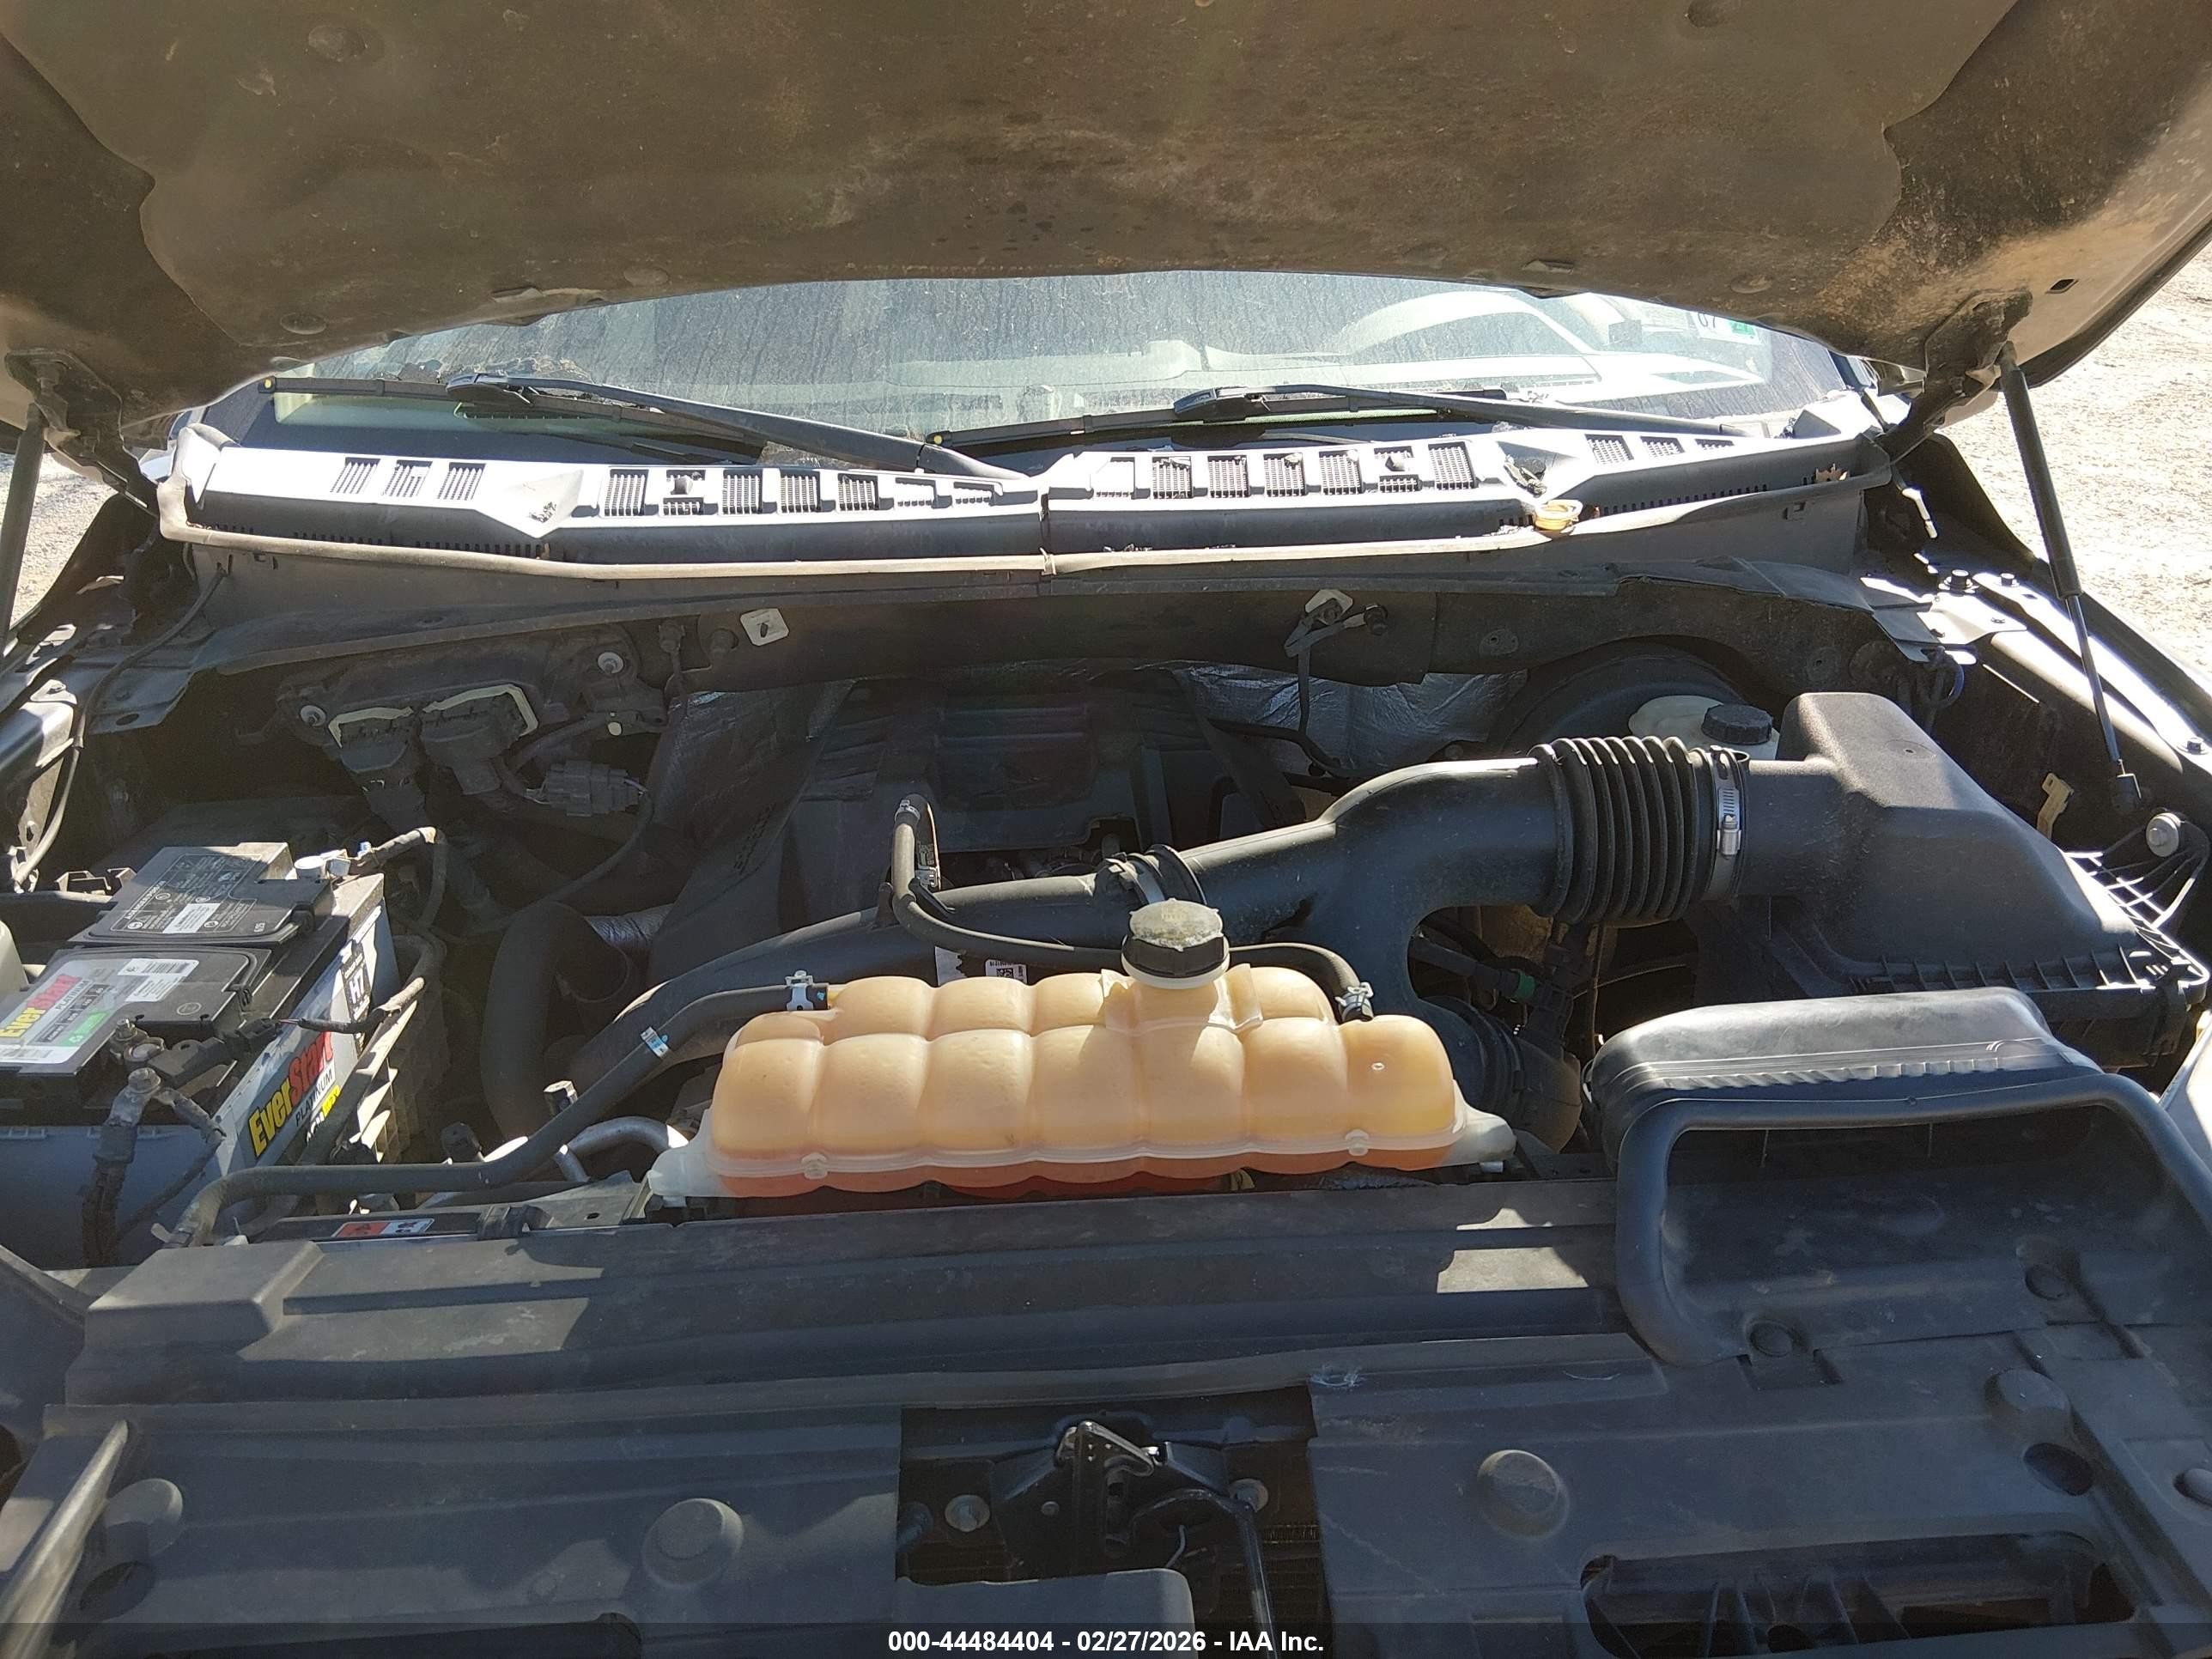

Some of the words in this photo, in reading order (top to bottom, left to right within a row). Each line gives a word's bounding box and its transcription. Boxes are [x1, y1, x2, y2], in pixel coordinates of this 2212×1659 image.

[349, 968, 365, 1005] H7
[248, 1030, 334, 1158] EverStart
[295, 1068, 333, 1127] PLATINUM
